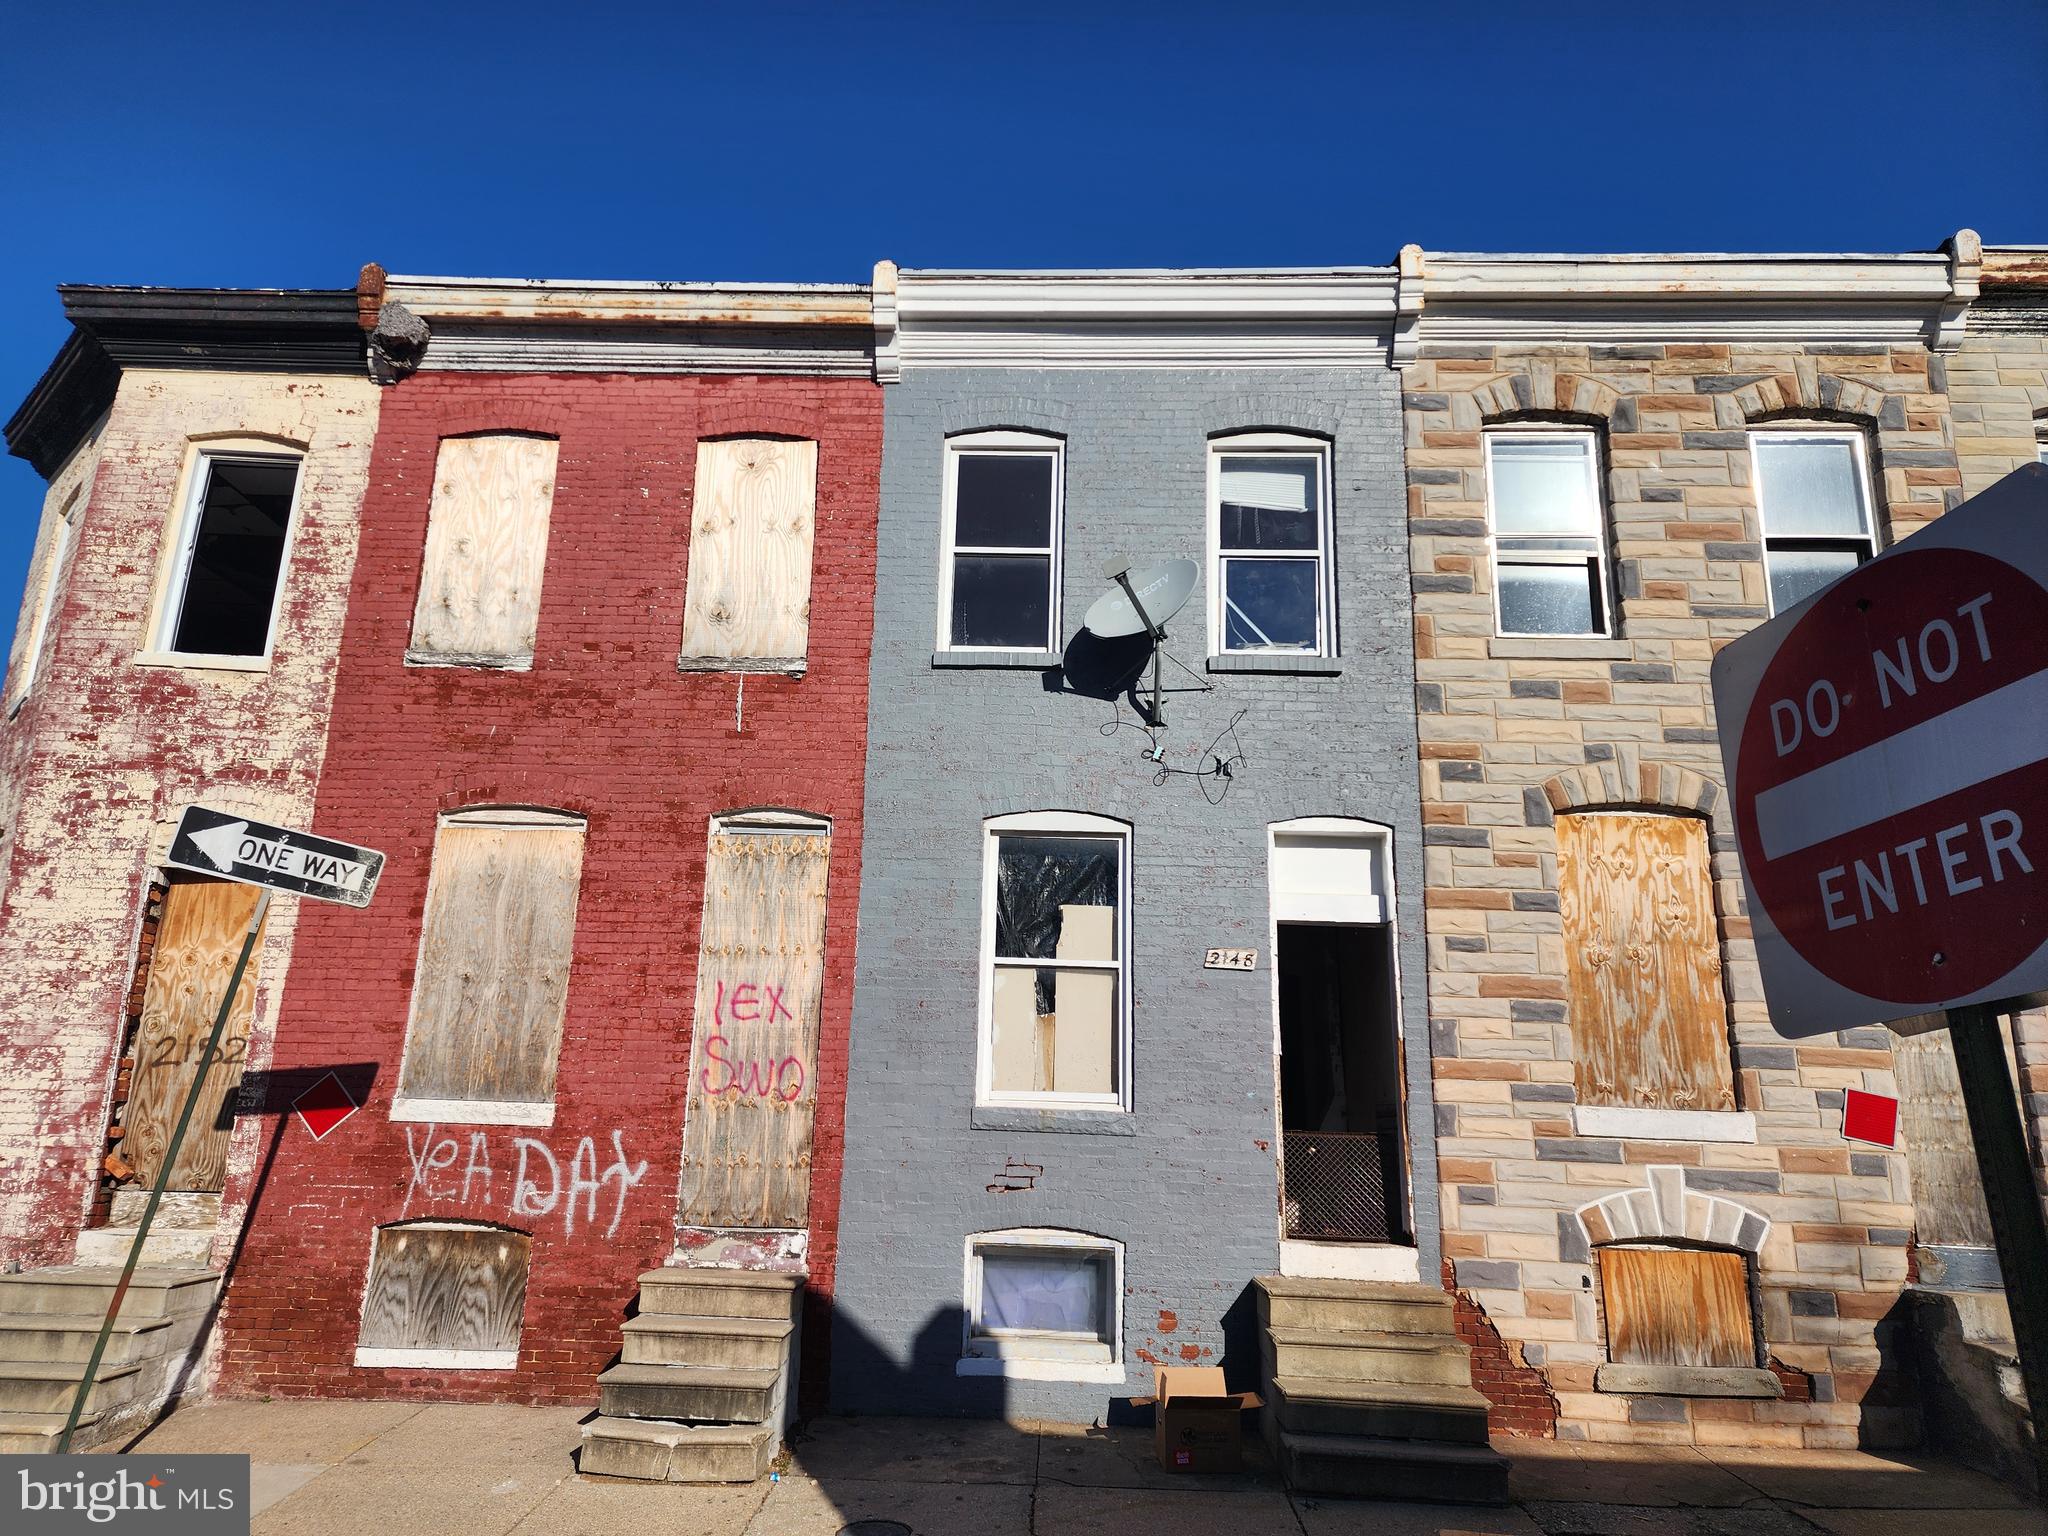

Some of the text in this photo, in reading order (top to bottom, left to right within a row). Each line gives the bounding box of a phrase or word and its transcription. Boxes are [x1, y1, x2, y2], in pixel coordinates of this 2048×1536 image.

[1123, 573, 1169, 606] DRECTV
[1770, 592, 1993, 758] DO NOT
[238, 839, 359, 884] ONE WAY
[1818, 809, 2035, 931] ENTER
